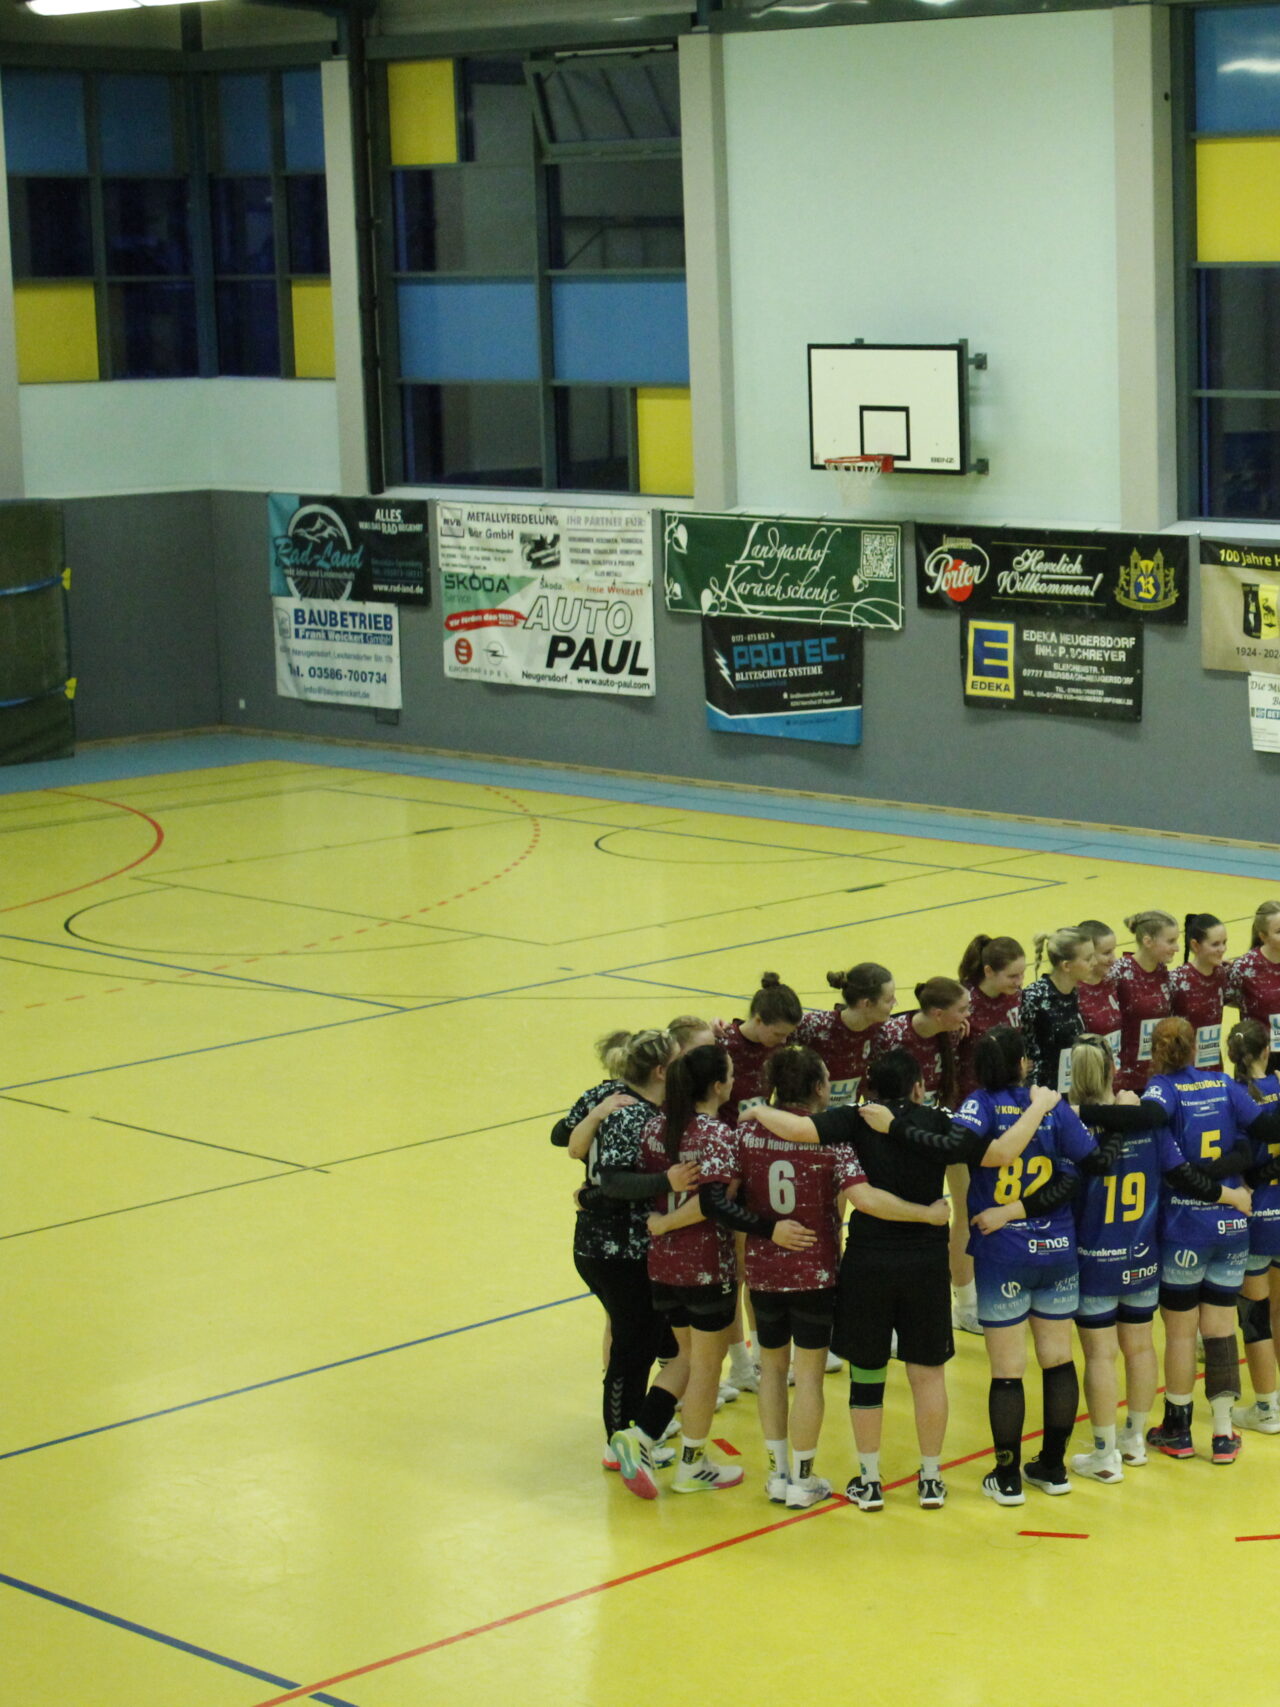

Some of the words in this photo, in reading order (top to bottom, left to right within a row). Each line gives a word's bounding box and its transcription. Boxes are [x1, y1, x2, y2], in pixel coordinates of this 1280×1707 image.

[467, 511, 559, 527] METALLVEREDELUNG
[566, 514, 582, 526] IHR
[584, 516, 622, 527] PARTNER
[381, 522, 398, 535] RAD
[486, 528, 515, 540] GmbH
[274, 536, 364, 570] Rad-Land
[735, 522, 842, 579] Landgasthof
[1219, 549, 1240, 563] 100
[1242, 552, 1272, 566] Jahre
[925, 544, 989, 594] Porter
[1013, 549, 1084, 575] Herzlich
[373, 583, 424, 595] www.rad-land.de
[997, 571, 1104, 597] Willkommen!
[293, 608, 393, 632] BAUBETRIEB
[523, 595, 633, 637] AUTO
[300, 629, 326, 641] Frank
[366, 633, 392, 645] GmbH
[1023, 629, 1057, 643] EDEKA
[1060, 632, 1136, 648] NEUGERSDORF
[545, 635, 649, 676] PAUL
[1069, 647, 1126, 662] SCHREYER
[1236, 646, 1257, 657] 1924
[522, 671, 568, 684] Neugersdorf
[735, 668, 788, 681] BLITZSCHUTZ
[788, 665, 823, 677] SYSTEME
[577, 676, 651, 690] www.auto-paul.com
[970, 681, 1011, 694] EDEKA
[1250, 680, 1266, 691] Die
[1001, 1104, 1022, 1115] KOW
[1200, 1129, 1222, 1162] 5
[768, 1159, 796, 1215] 6
[994, 1155, 1053, 1205] 82
[1103, 1171, 1146, 1224] 19
[1028, 1236, 1070, 1253] genos
[1077, 1246, 1127, 1258] Rosenkranz
[1122, 1262, 1158, 1285] genos
